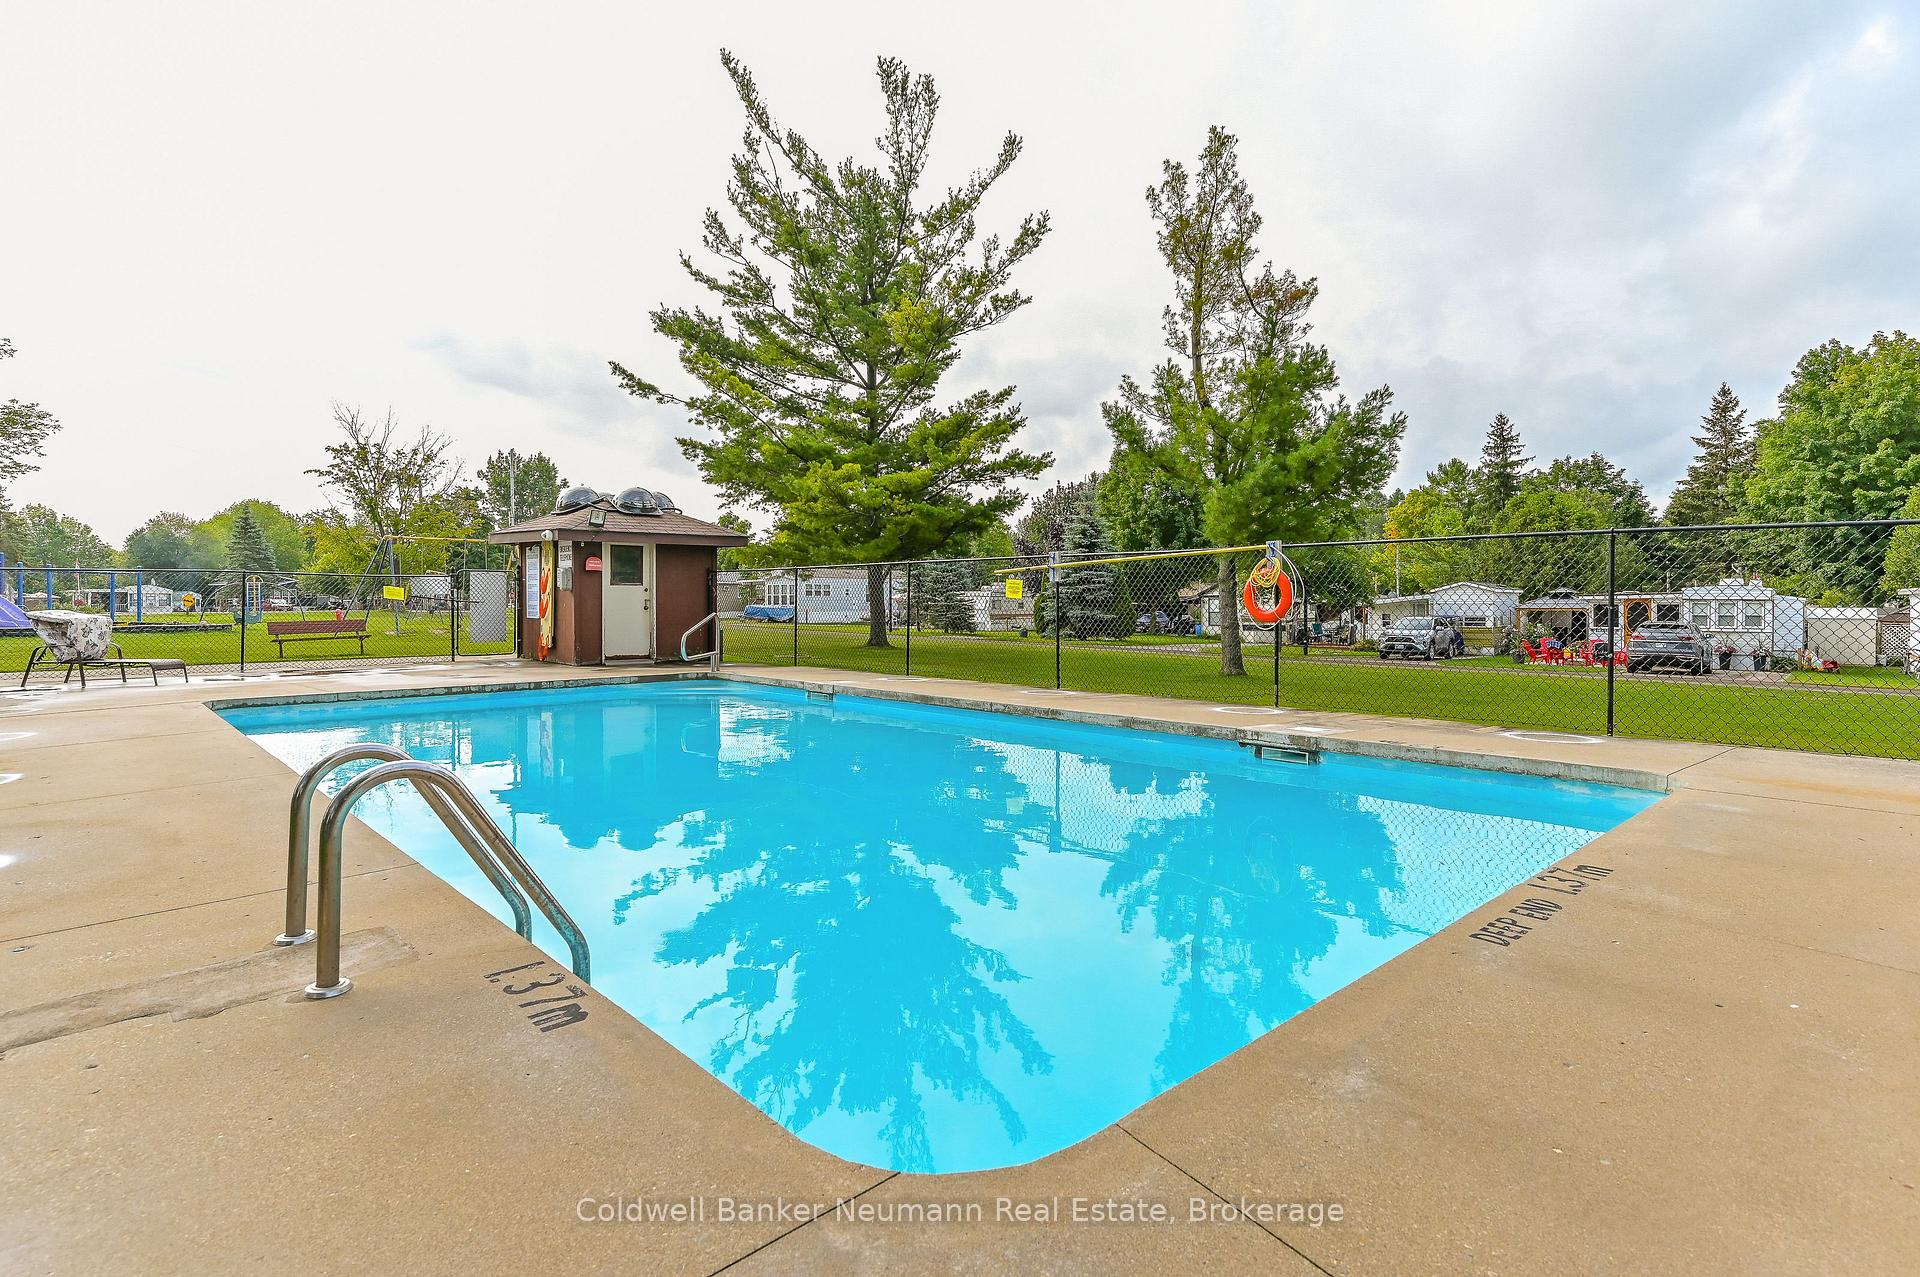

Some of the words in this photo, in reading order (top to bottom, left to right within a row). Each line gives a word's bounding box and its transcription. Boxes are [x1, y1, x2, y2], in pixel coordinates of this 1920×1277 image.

[1527, 864, 1614, 896] 1.37m
[1508, 898, 1563, 921] END
[1469, 916, 1533, 947] DEEP
